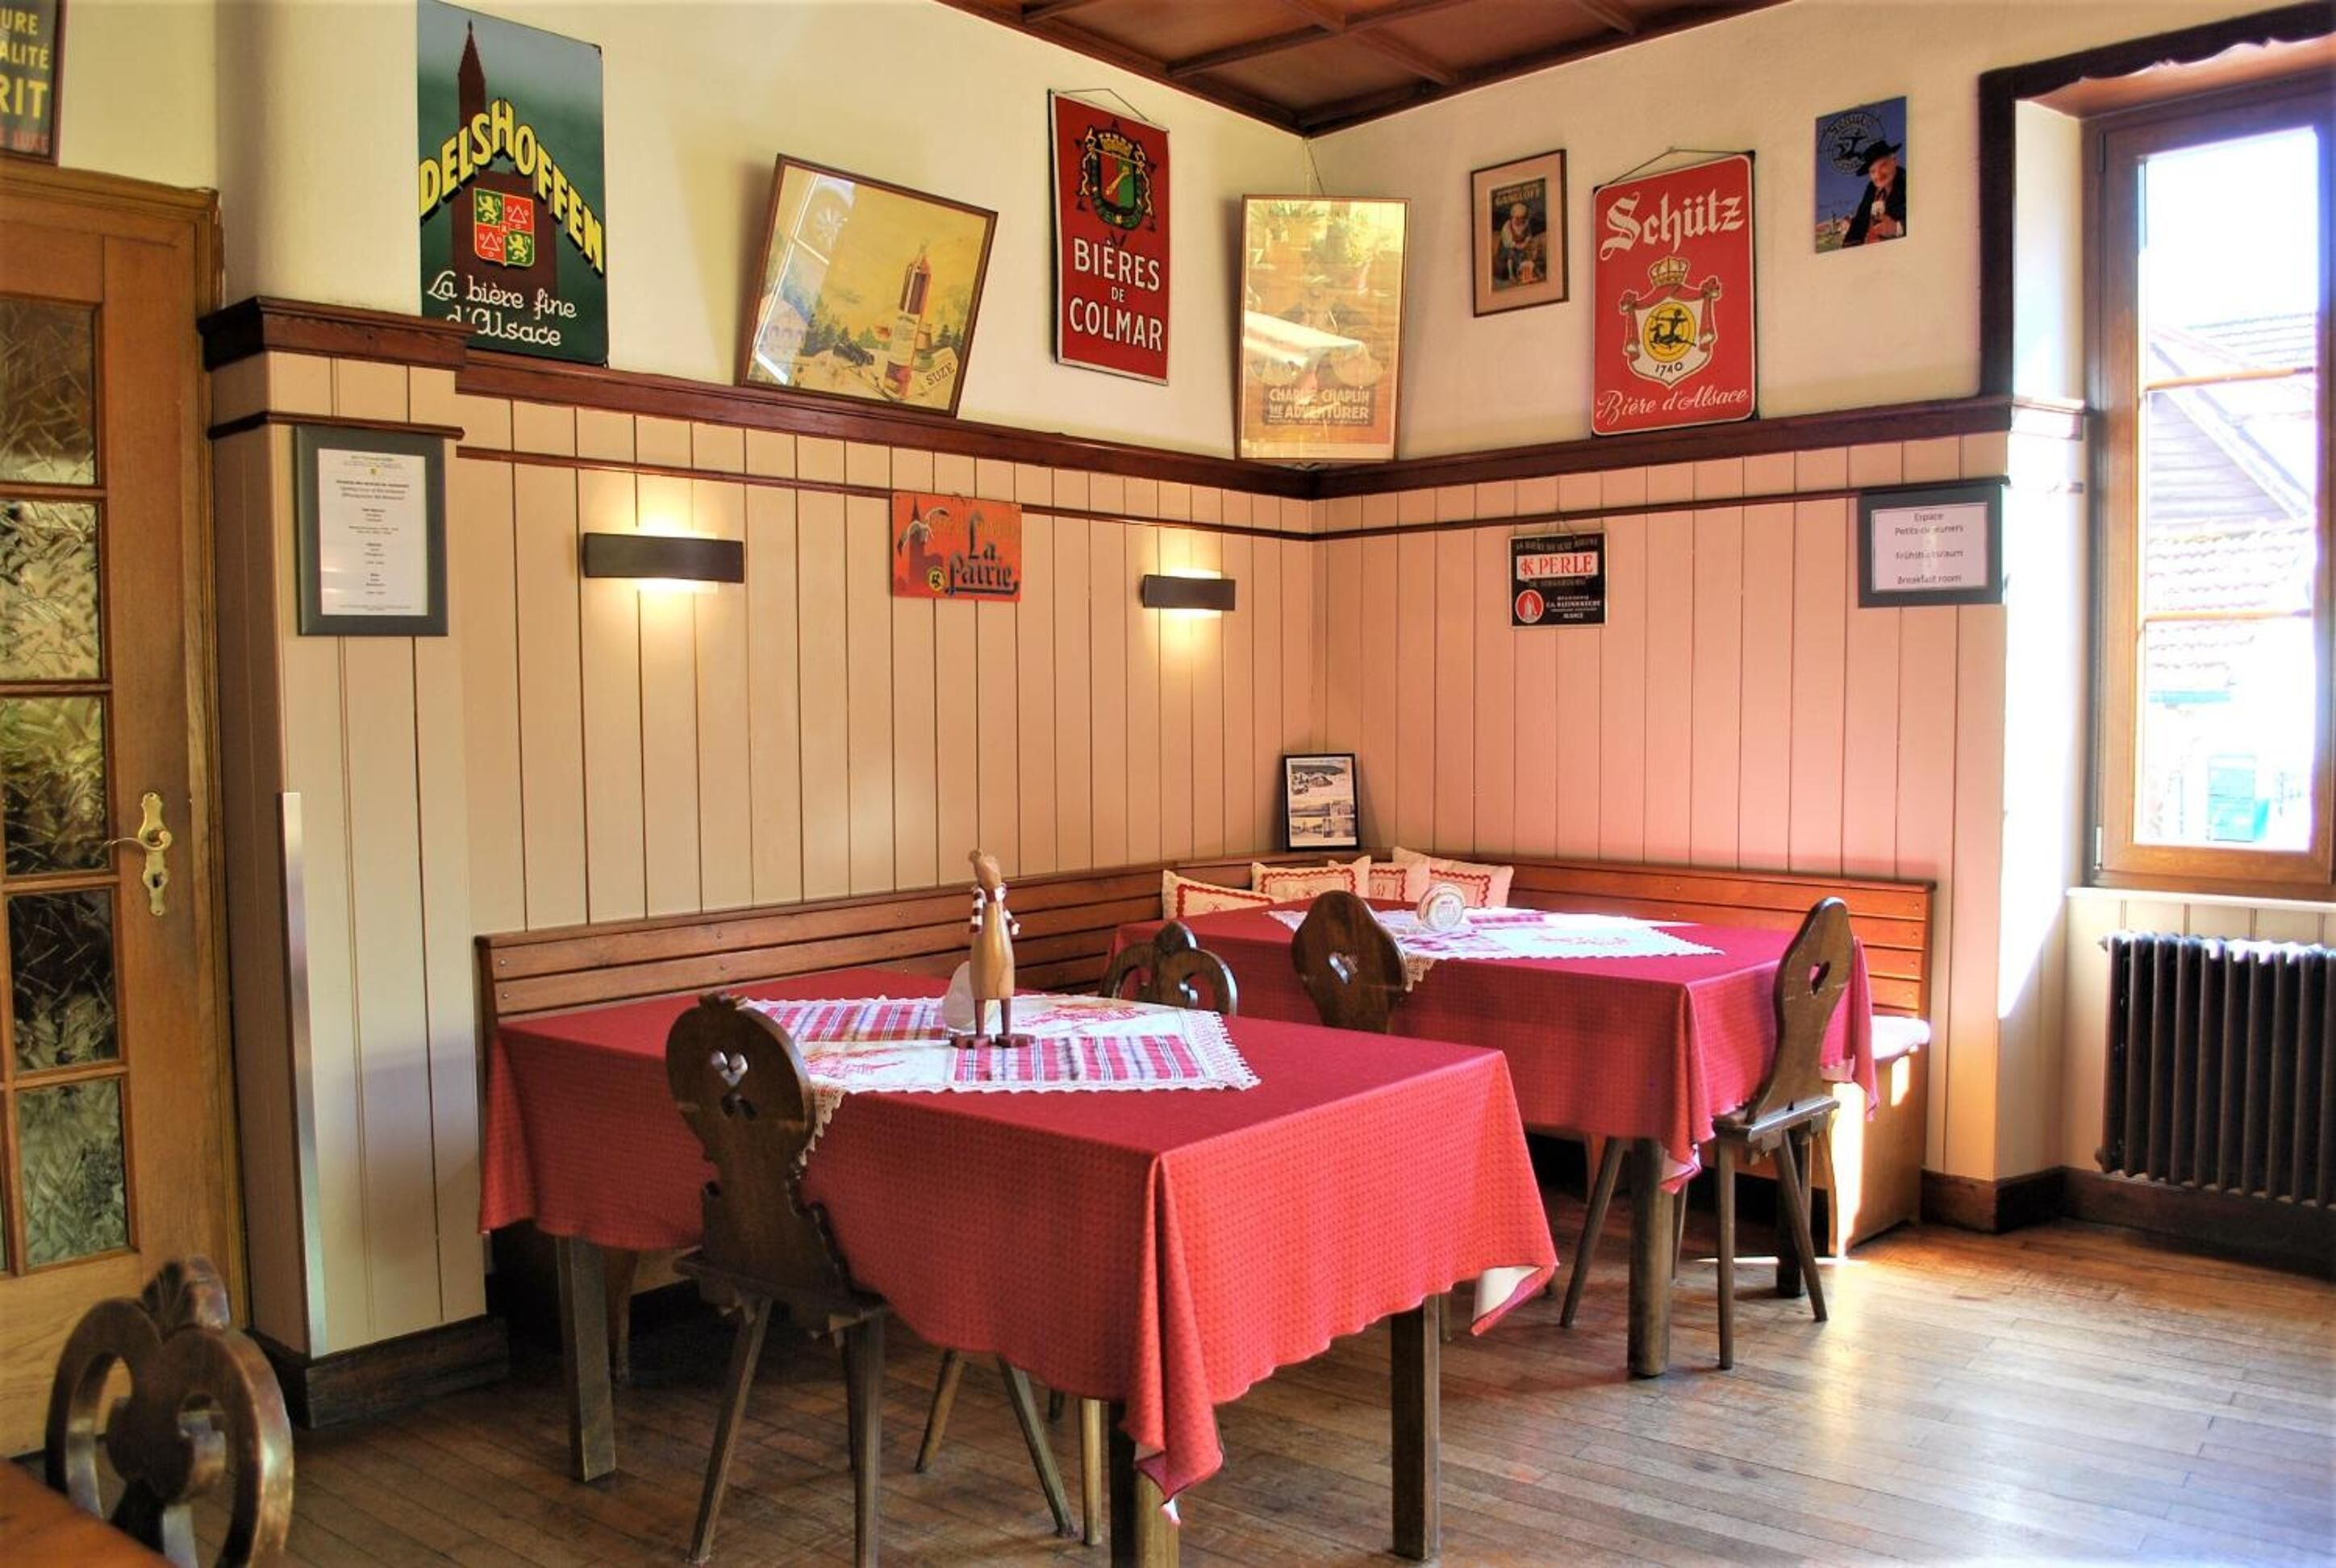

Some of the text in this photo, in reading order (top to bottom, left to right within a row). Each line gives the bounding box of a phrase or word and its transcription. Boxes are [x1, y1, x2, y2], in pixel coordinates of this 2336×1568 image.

[419, 98, 604, 275] DELSHOFFEN
[1600, 189, 1744, 261] Schütz
[1074, 238, 1160, 291] BIÈRES
[427, 270, 577, 320] La bière fine
[1111, 286, 1125, 303] DE
[446, 305, 561, 346] d'Alsace
[1069, 296, 1162, 352] COLMAR
[926, 361, 956, 385] SUZE
[1596, 385, 1749, 425] Bière d'Alsace
[1895, 524, 1964, 536] Petits-déeuners
[1539, 554, 1594, 575] PERLE
